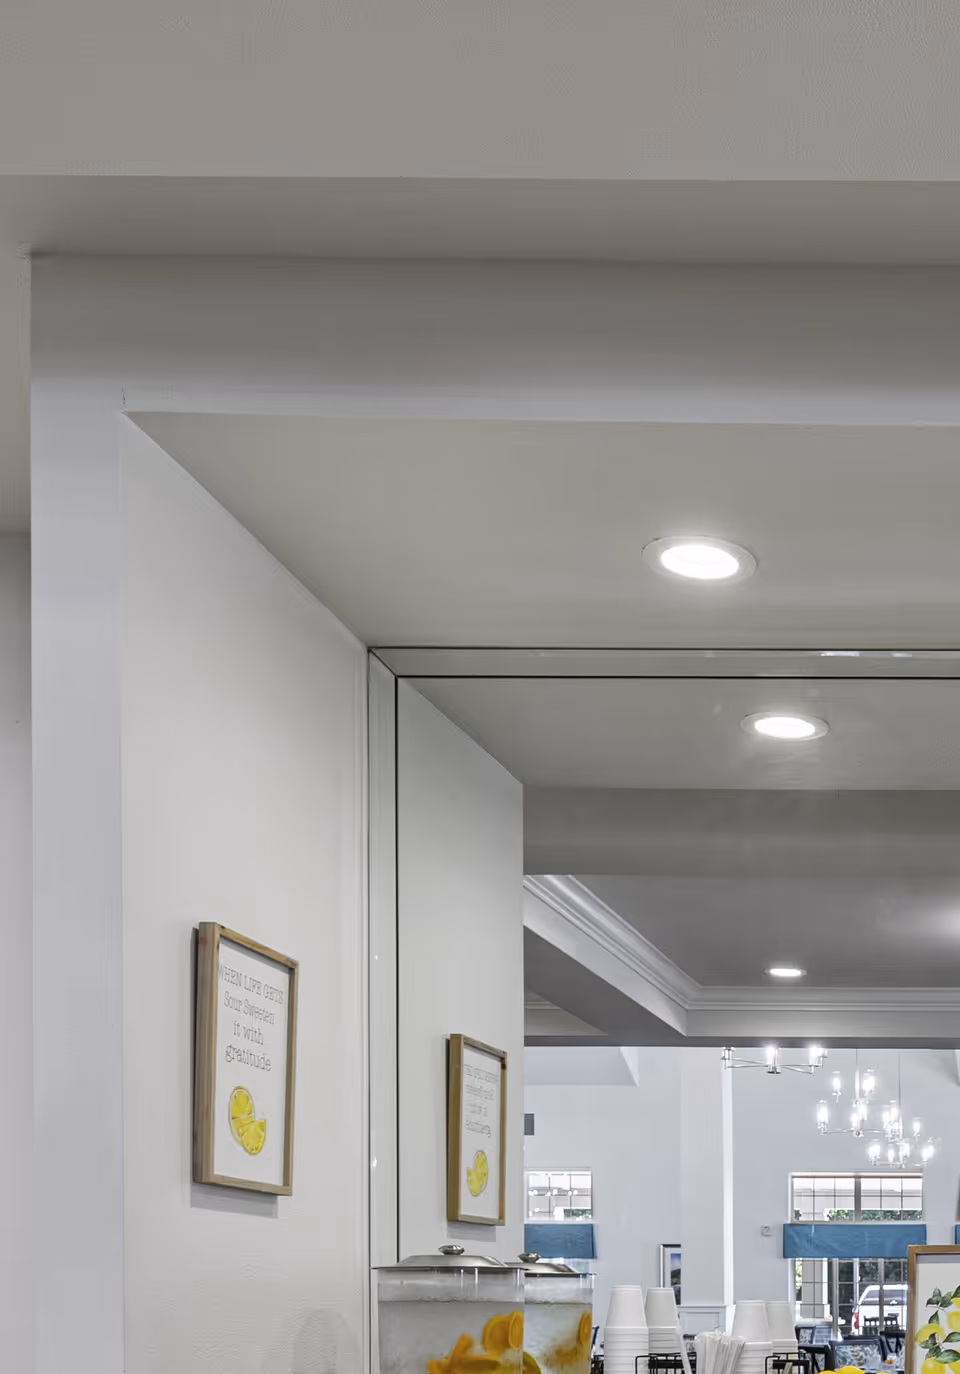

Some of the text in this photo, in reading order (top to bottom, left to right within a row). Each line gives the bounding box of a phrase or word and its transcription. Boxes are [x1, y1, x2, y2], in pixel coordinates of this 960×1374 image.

[223, 990, 243, 1012] Sour
[243, 974, 262, 996] LIFE
[263, 983, 284, 1005] GETS
[233, 1020, 264, 1046] it with
[224, 1044, 272, 1072] gratitude
